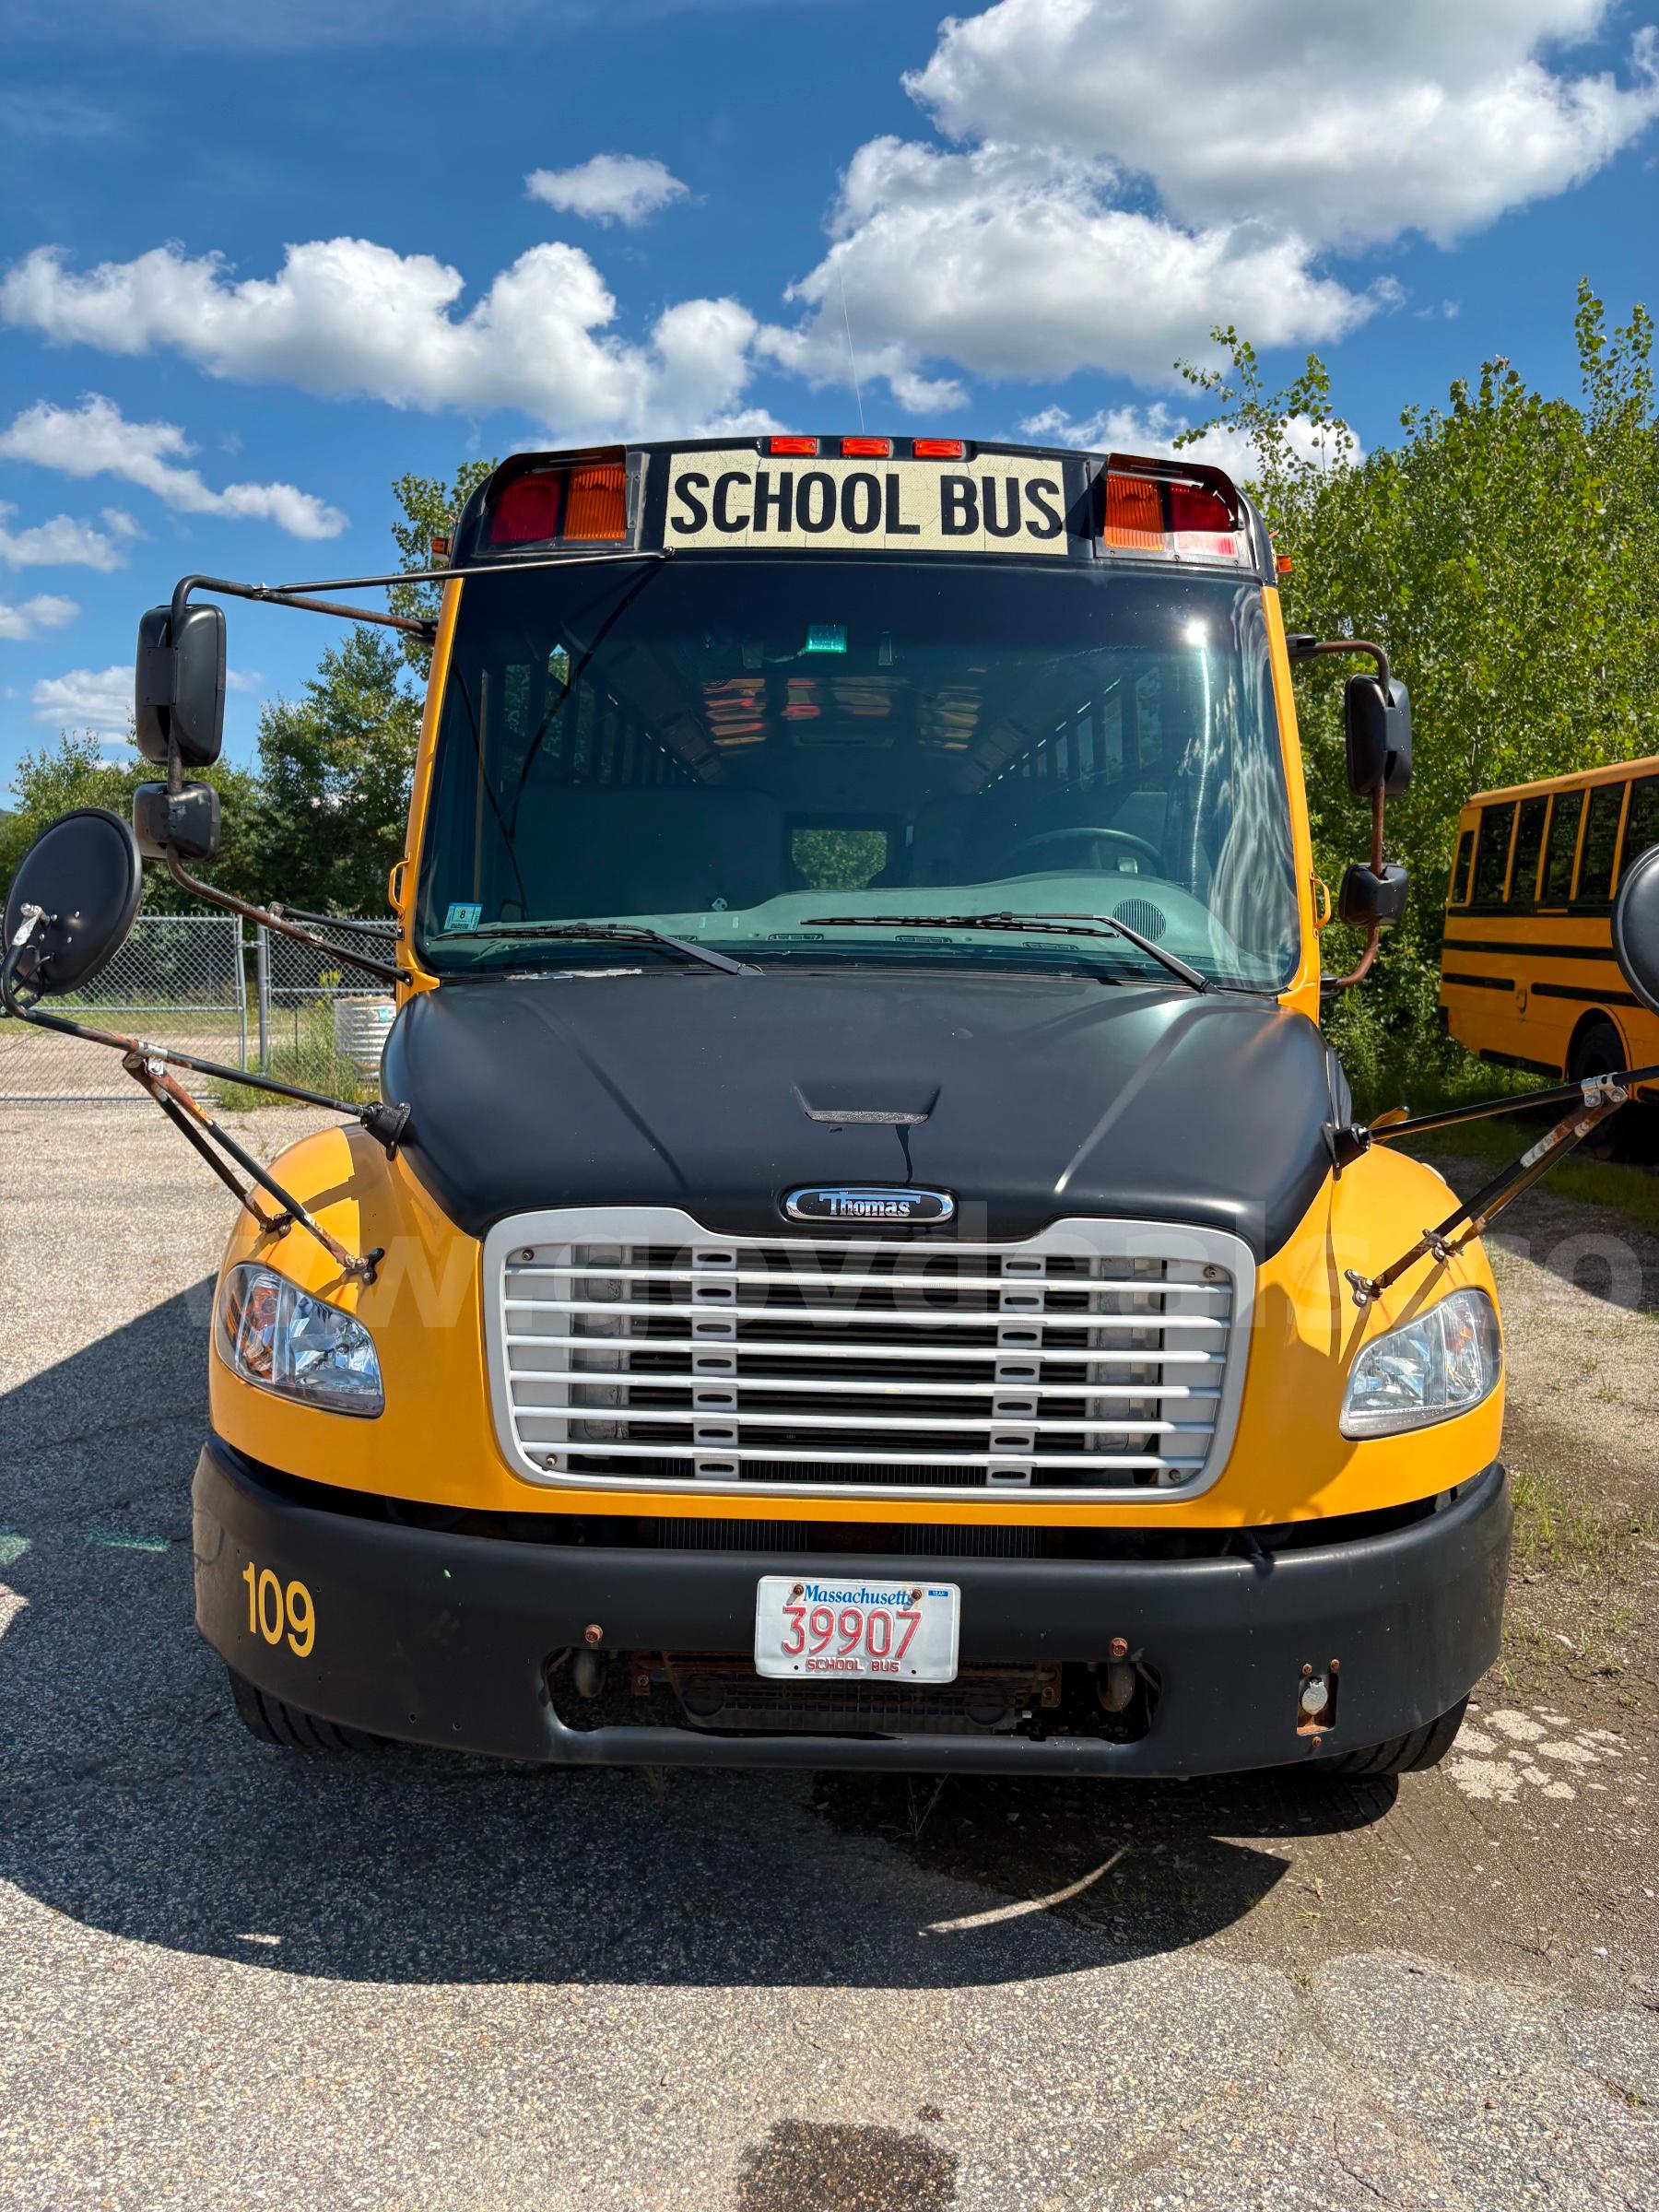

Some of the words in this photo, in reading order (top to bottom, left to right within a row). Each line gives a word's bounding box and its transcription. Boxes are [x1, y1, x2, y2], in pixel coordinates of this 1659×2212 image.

[671, 472, 920, 535] SCHOOL
[941, 475, 1063, 539] BUS
[460, 910, 466, 919] 8
[819, 1191, 921, 1217] Thomas
[804, 1584, 913, 1606] Massachusetts
[242, 1561, 316, 1658] 109
[782, 1606, 923, 1659] 39907
[807, 1657, 865, 1671] SCHOOL
[871, 1659, 900, 1673] BUS
